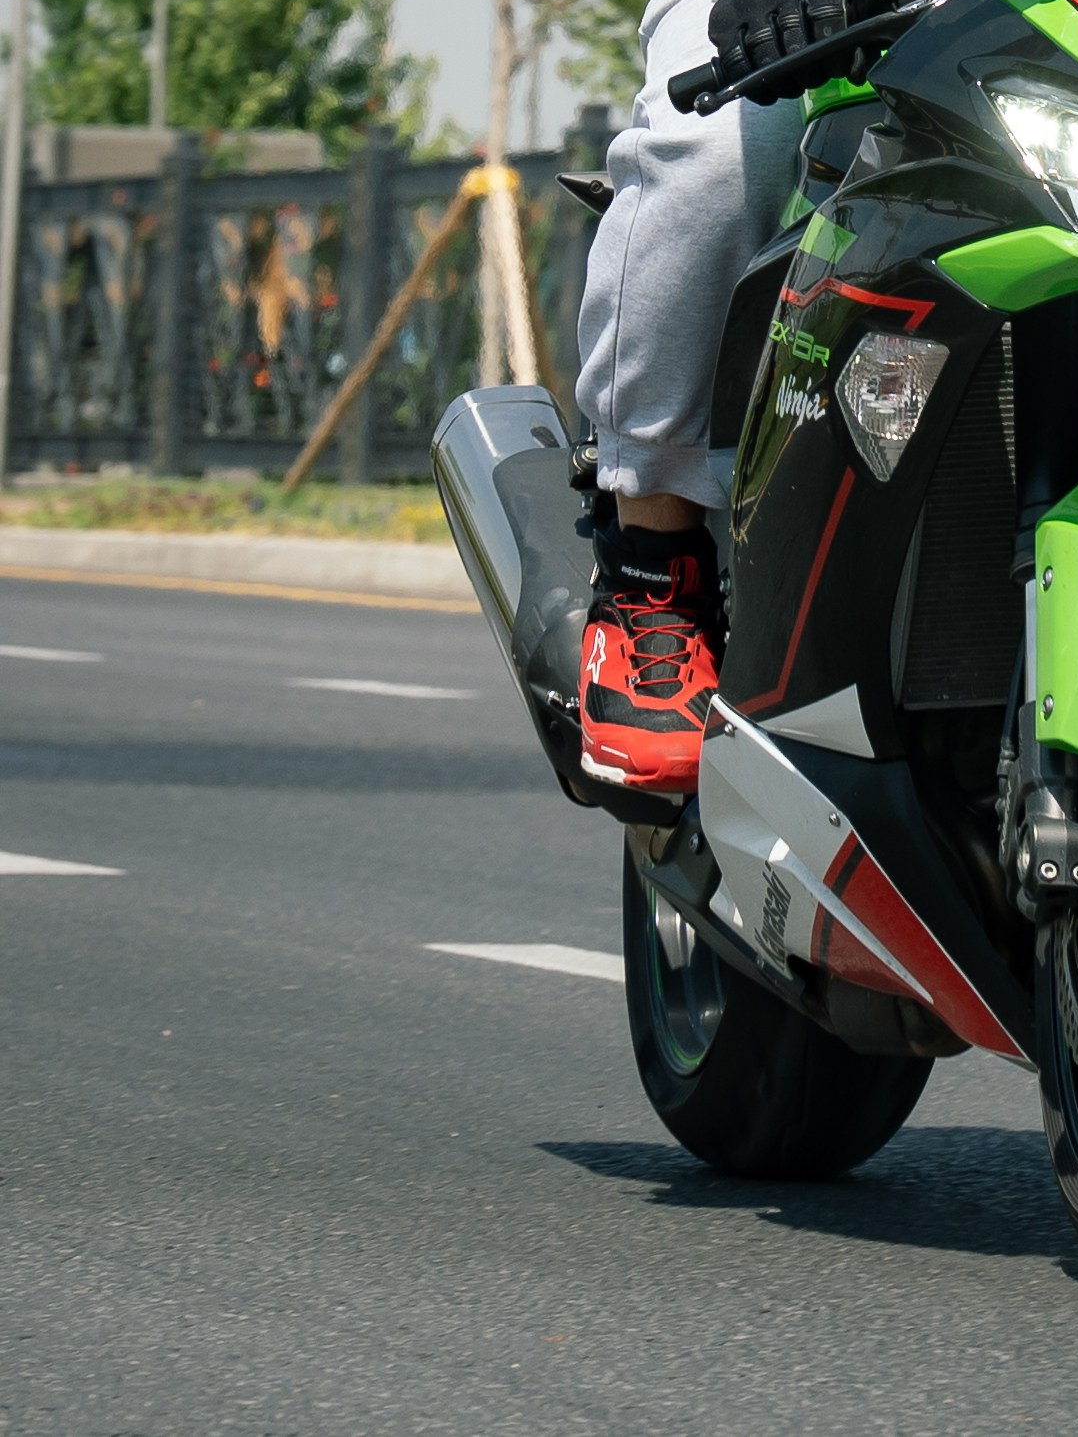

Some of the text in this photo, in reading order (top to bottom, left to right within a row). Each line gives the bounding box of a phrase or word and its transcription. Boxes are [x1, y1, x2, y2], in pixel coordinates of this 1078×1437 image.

[769, 320, 830, 368] ZX-6R
[776, 373, 826, 431] Ninja
[754, 860, 792, 973] Kawasaki
